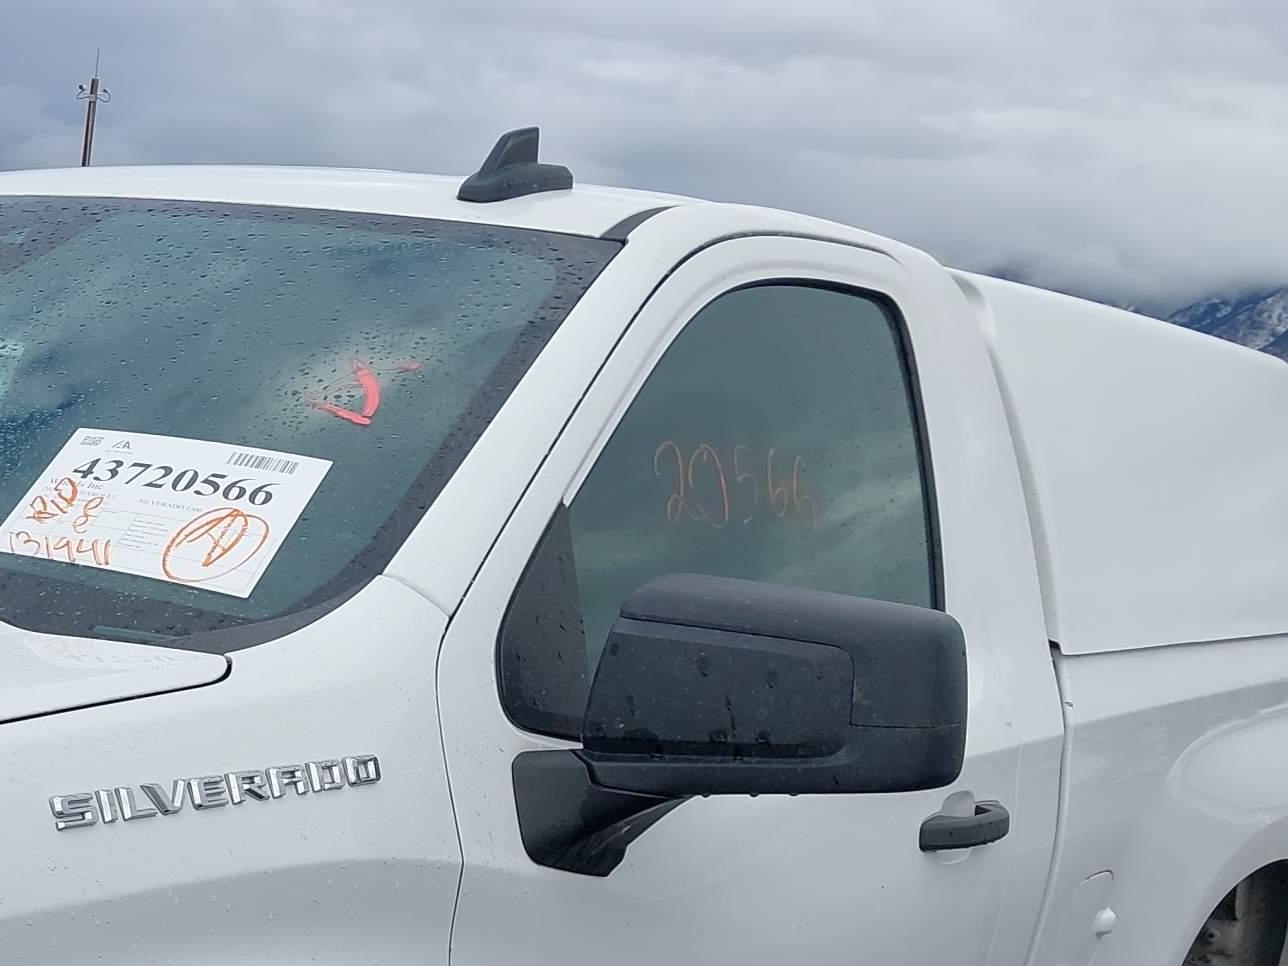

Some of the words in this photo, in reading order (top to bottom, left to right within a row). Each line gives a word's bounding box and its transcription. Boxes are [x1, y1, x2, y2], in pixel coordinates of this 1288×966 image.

[72, 456, 280, 506] 43720566
[654, 441, 816, 529] 20566
[48, 753, 383, 832] SILVERADO
